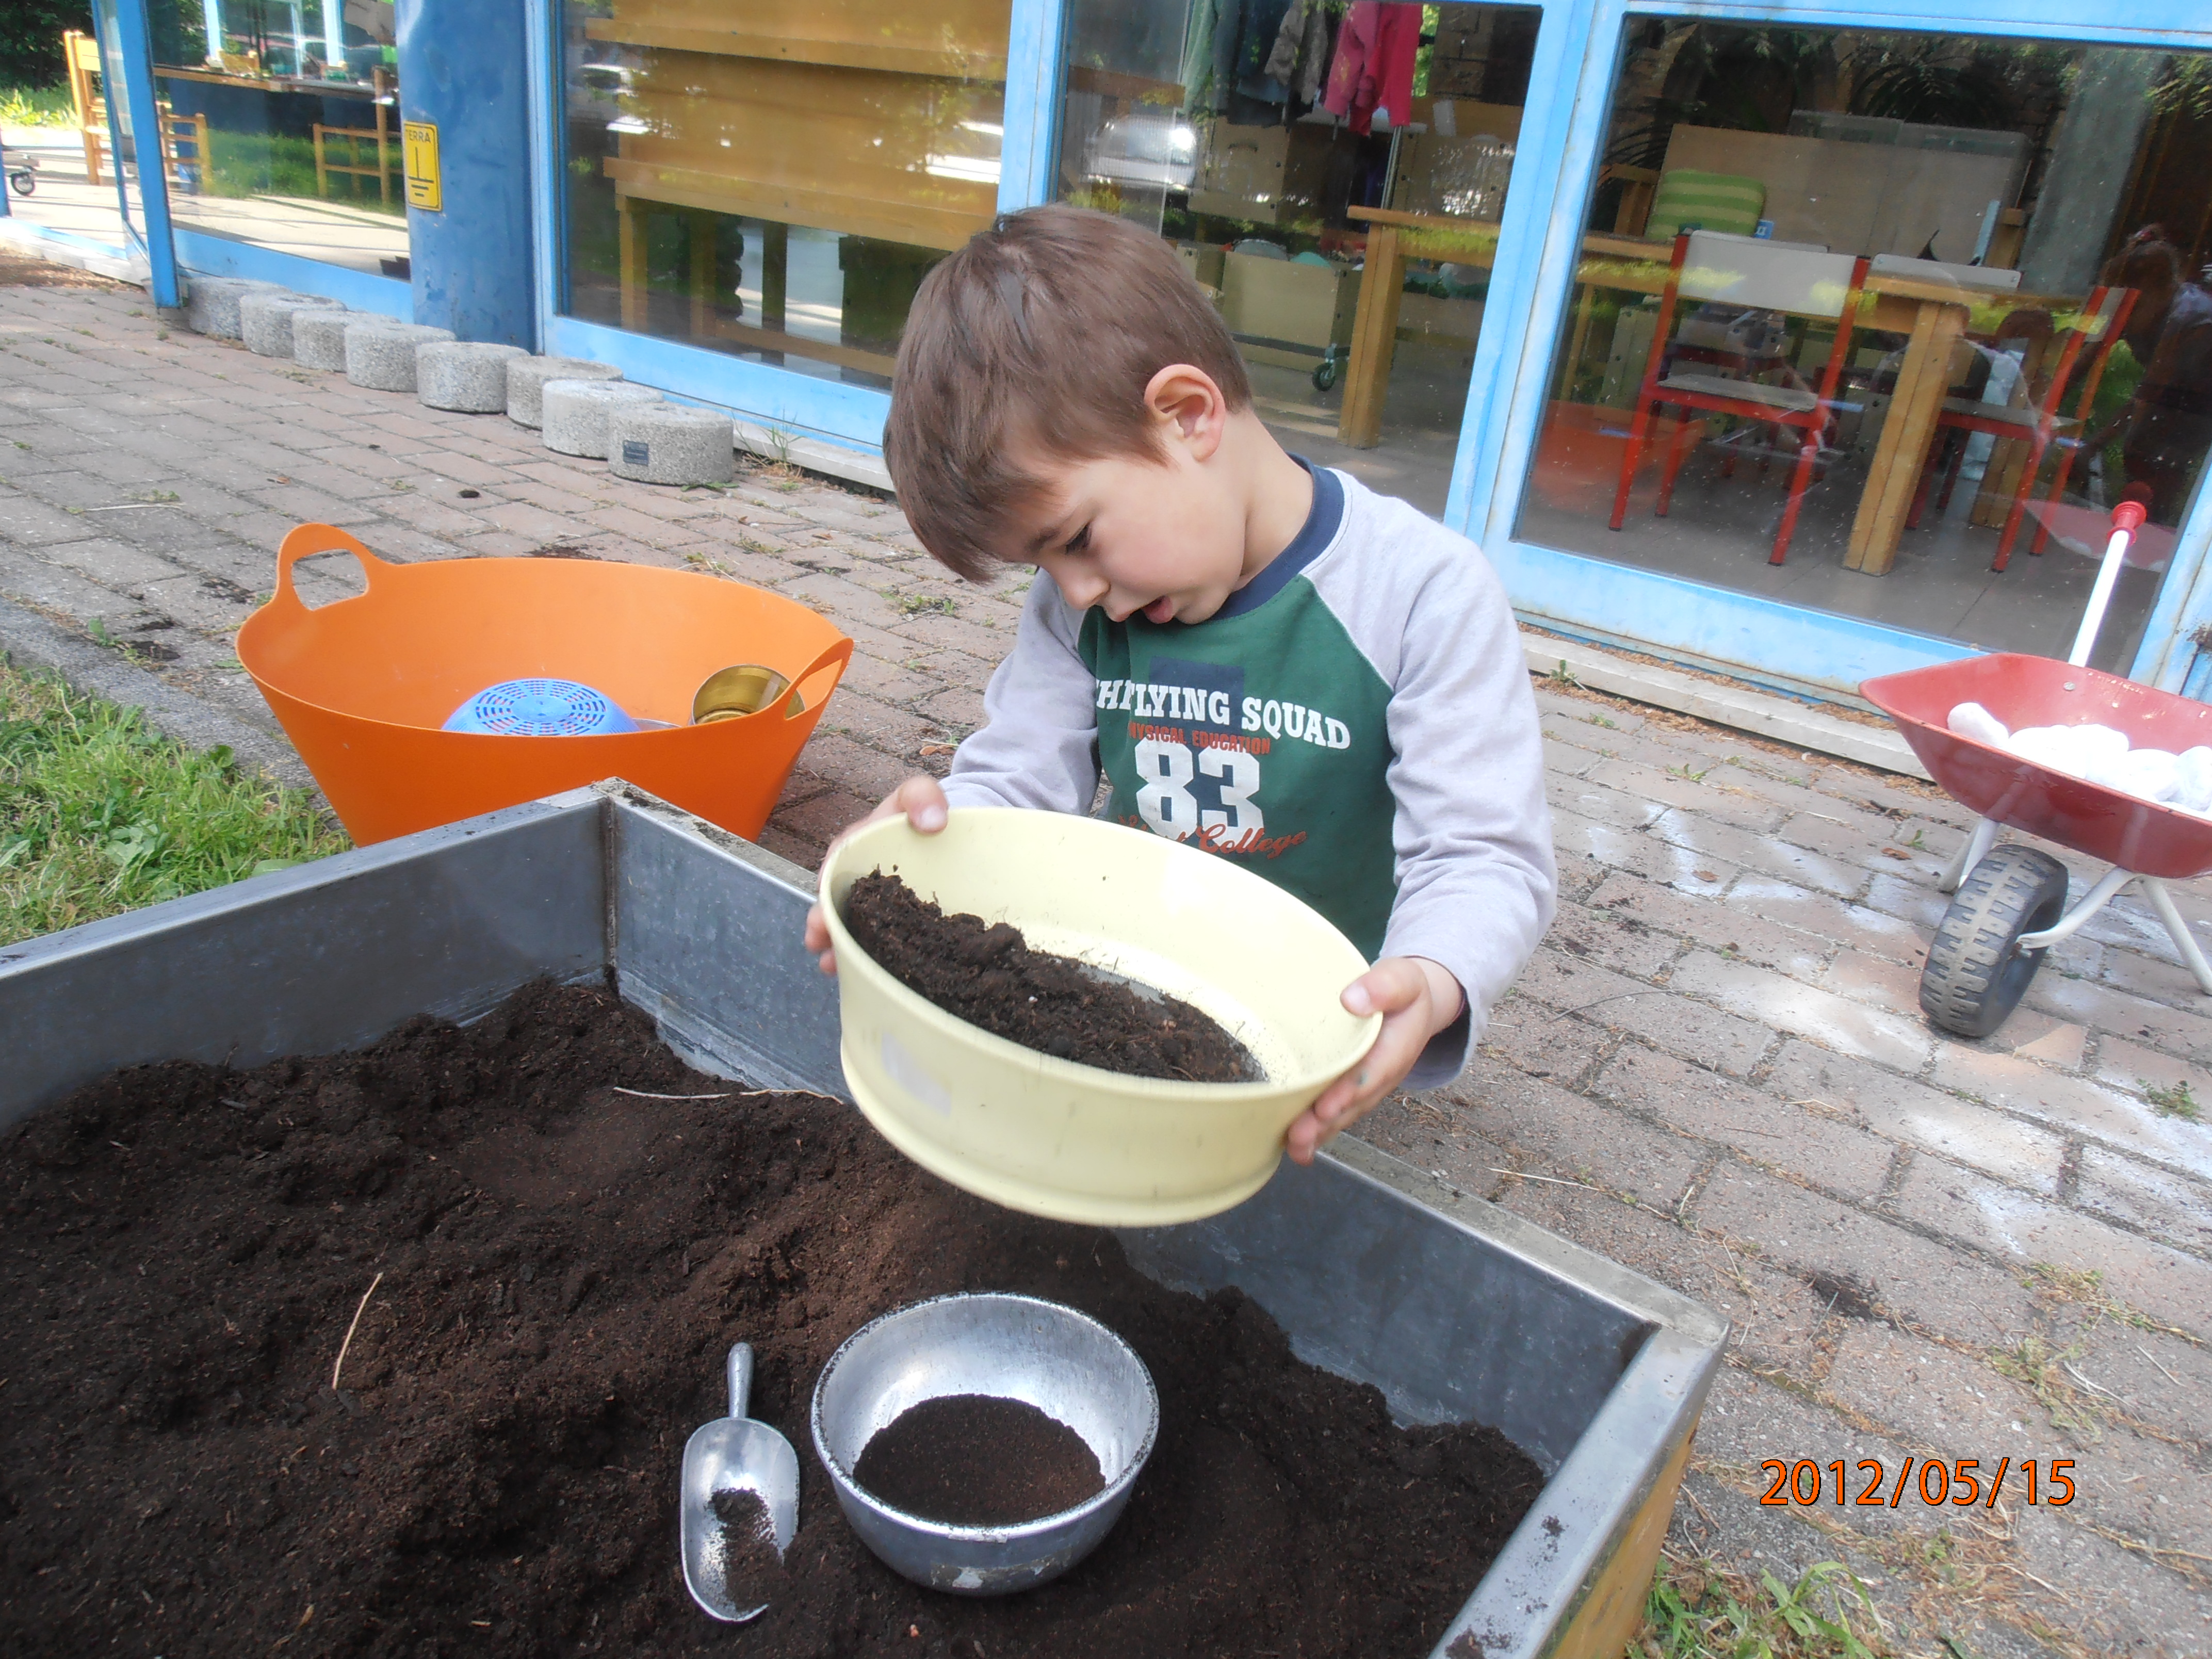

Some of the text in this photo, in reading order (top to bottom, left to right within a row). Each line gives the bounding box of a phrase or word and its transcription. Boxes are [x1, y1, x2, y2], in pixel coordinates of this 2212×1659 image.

[1192, 730, 1271, 755] EDUCATION
[1241, 697, 1351, 750] SQUAD
[1135, 734, 1264, 847] 83
[1195, 823, 1307, 860] College
